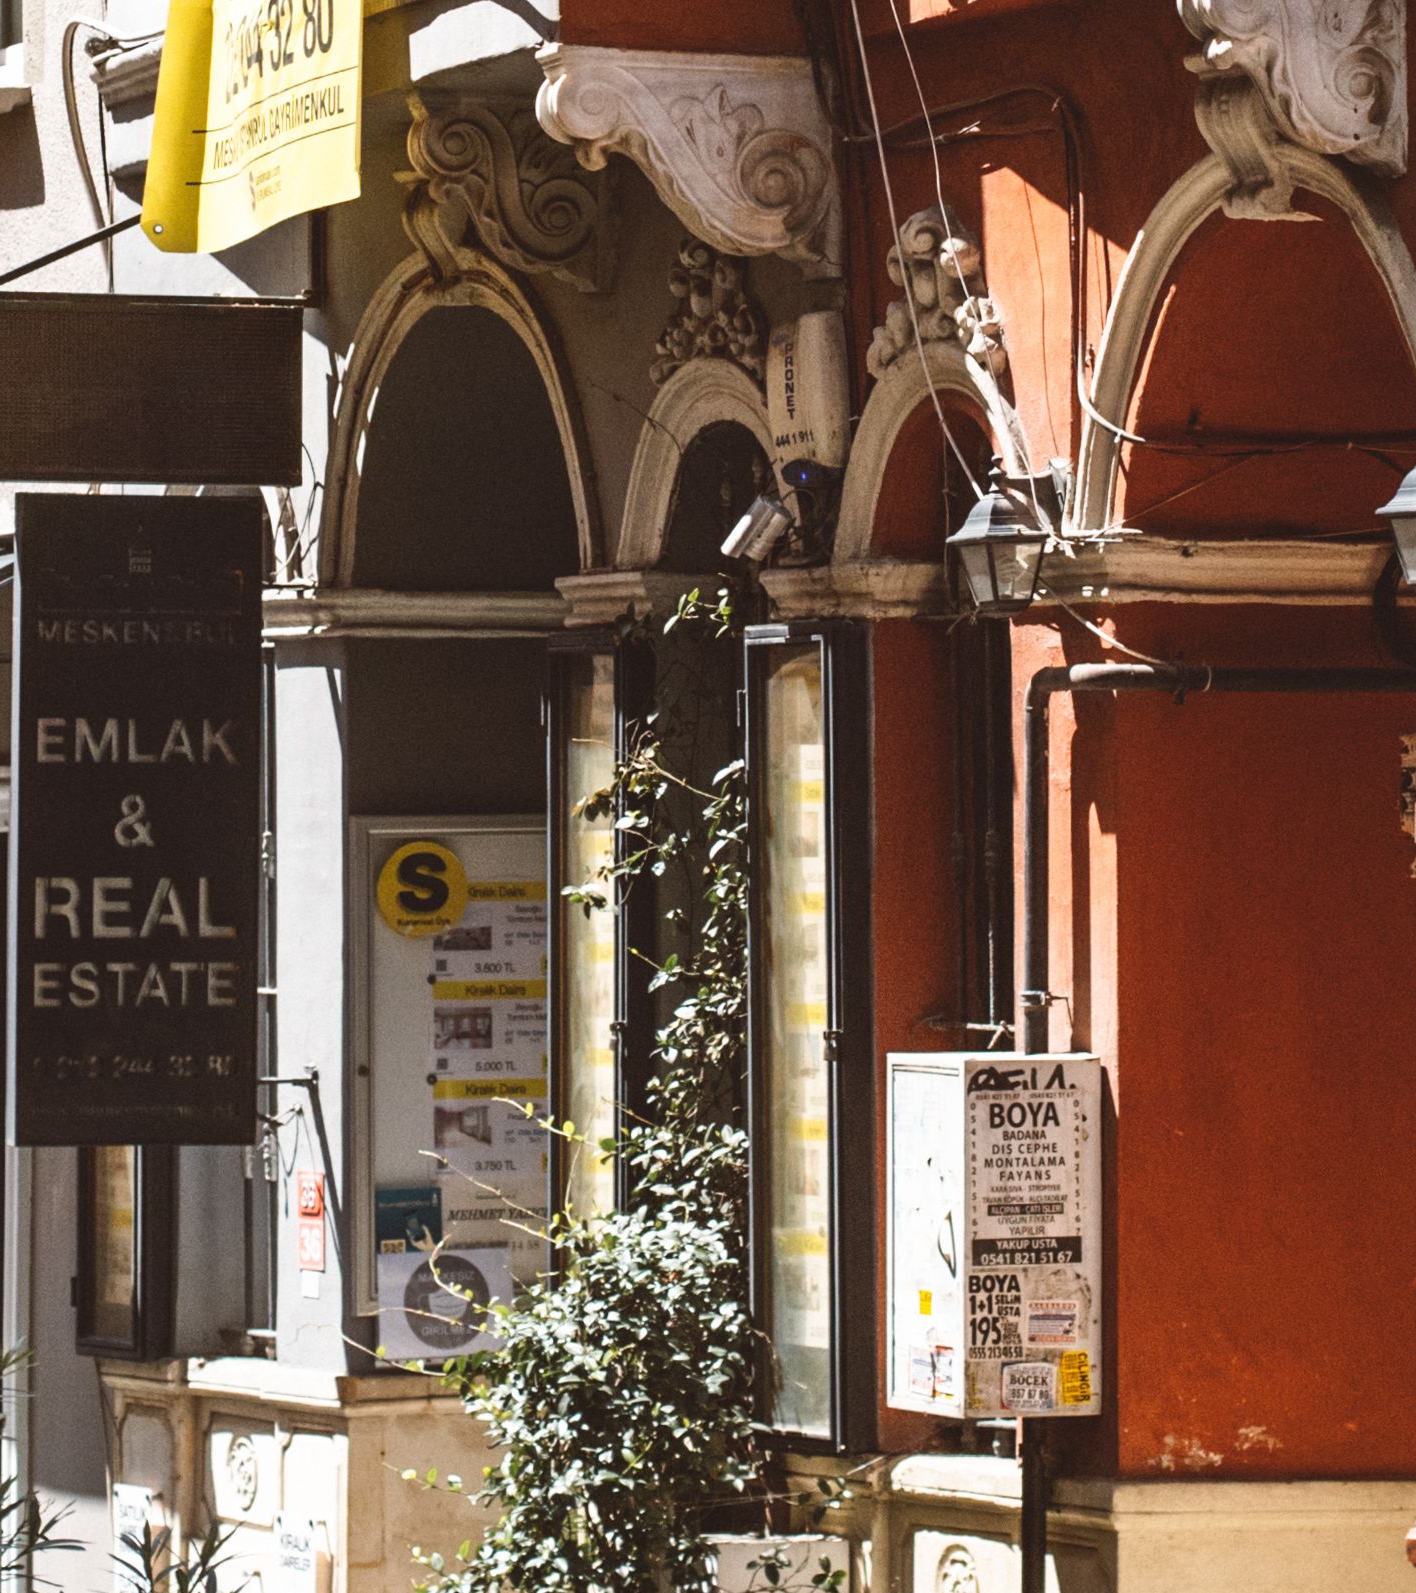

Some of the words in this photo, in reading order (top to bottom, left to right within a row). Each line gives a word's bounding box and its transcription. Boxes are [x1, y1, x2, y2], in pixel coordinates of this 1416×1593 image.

[36, 716, 238, 765] EMLAK
[113, 792, 156, 850] &
[397, 852, 450, 913] S
[33, 876, 238, 941] REAL
[32, 960, 238, 1009] ESTATE
[989, 1102, 1060, 1129] BOYA
[1002, 1130, 1047, 1141] BADANA
[1018, 1142, 1058, 1154] CEPHE
[984, 1156, 1066, 1168] MONTALAMA
[999, 1170, 1051, 1182] FAYANS
[998, 1216, 1027, 1225] UYGUN
[1009, 1226, 1045, 1235] YAPILIR
[996, 1240, 1030, 1250] YAKUP
[1032, 1239, 1057, 1249] USTA
[980, 1253, 1010, 1265] 0541
[1014, 1253, 1035, 1264] 821
[1039, 1252, 1054, 1263] 51
[1057, 1251, 1072, 1262] 67
[968, 1275, 1021, 1293] BOYA
[969, 1295, 993, 1315] 1+1
[997, 1306, 1021, 1317] USTA
[970, 1317, 1001, 1346] 195
